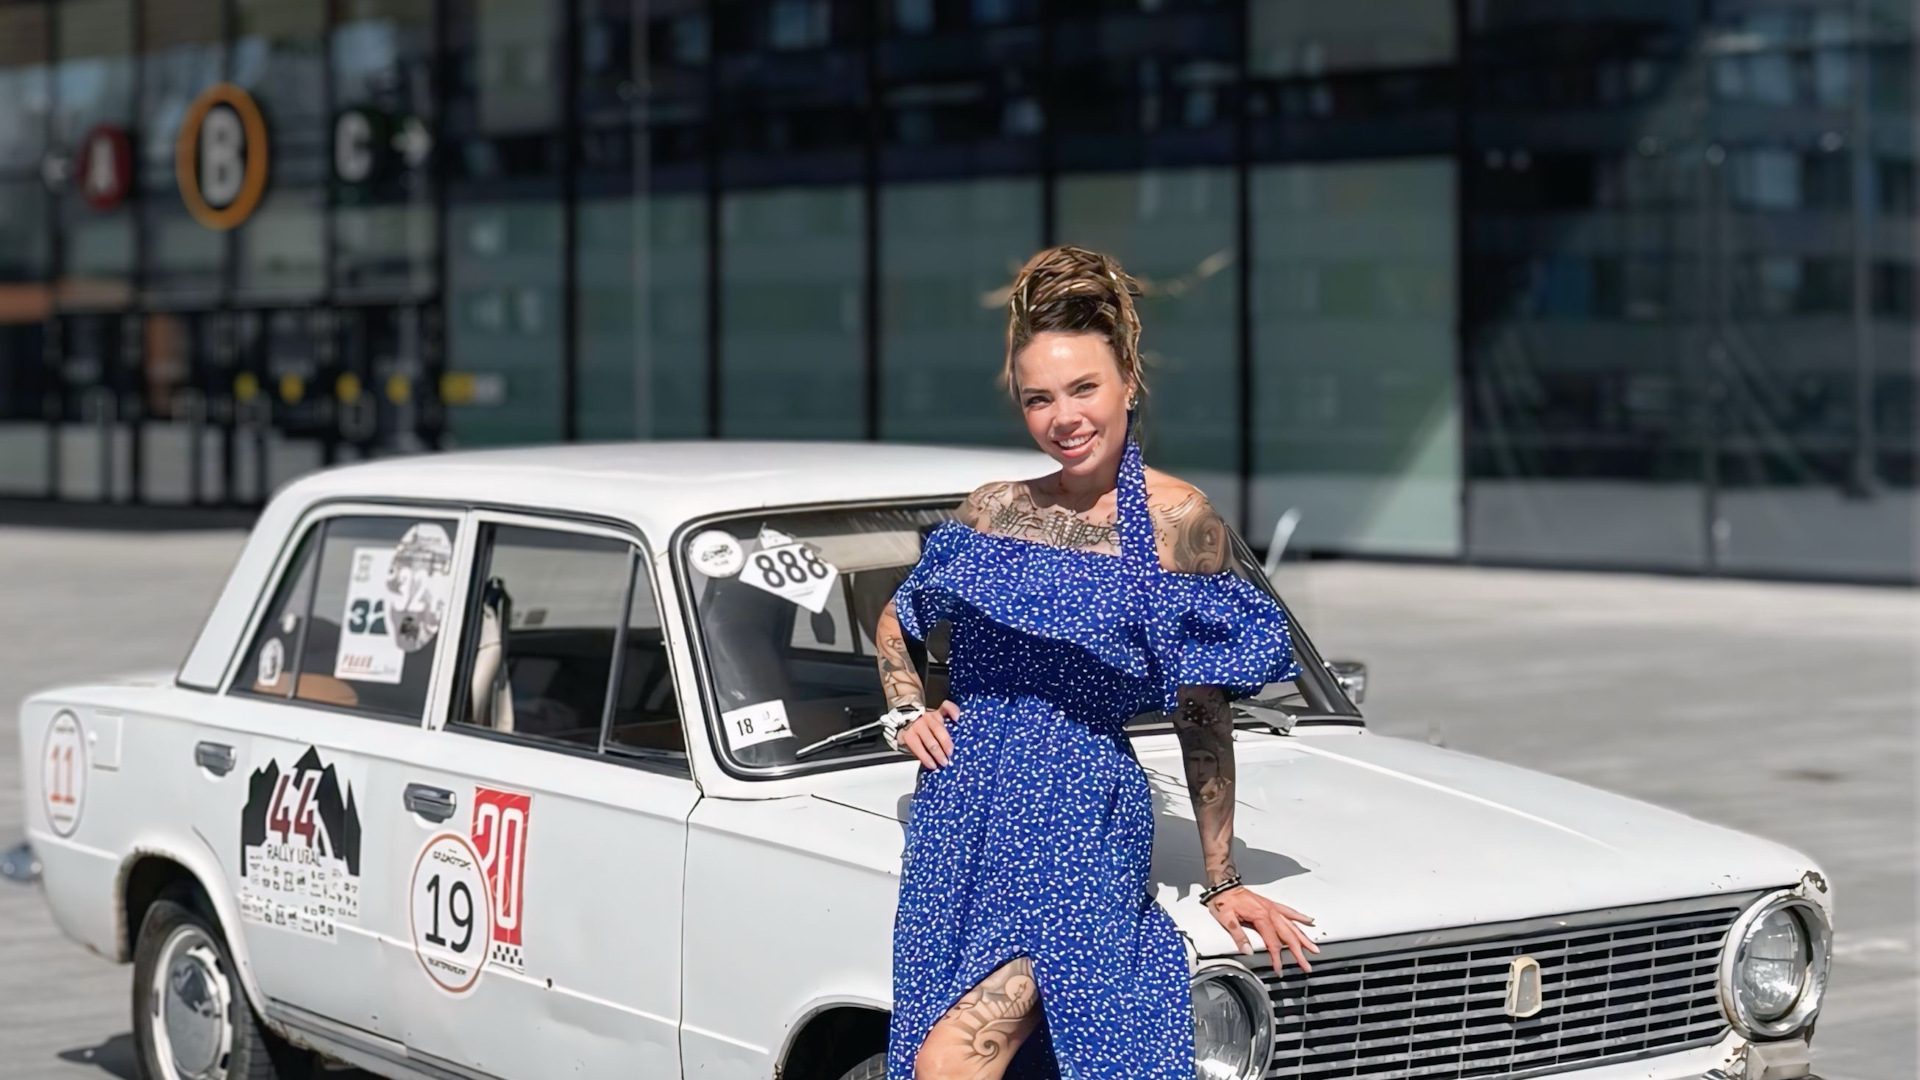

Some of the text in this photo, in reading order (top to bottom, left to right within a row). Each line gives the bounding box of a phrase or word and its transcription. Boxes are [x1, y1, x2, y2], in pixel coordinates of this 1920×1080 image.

[84, 134, 118, 194] A
[202, 106, 244, 207] B
[335, 111, 372, 182] C
[755, 547, 828, 588] 888
[736, 718, 754, 736] 18
[50, 744, 75, 805] 11
[270, 774, 316, 849] 44
[267, 844, 322, 868] RALLY URAL
[425, 874, 474, 953] 19
